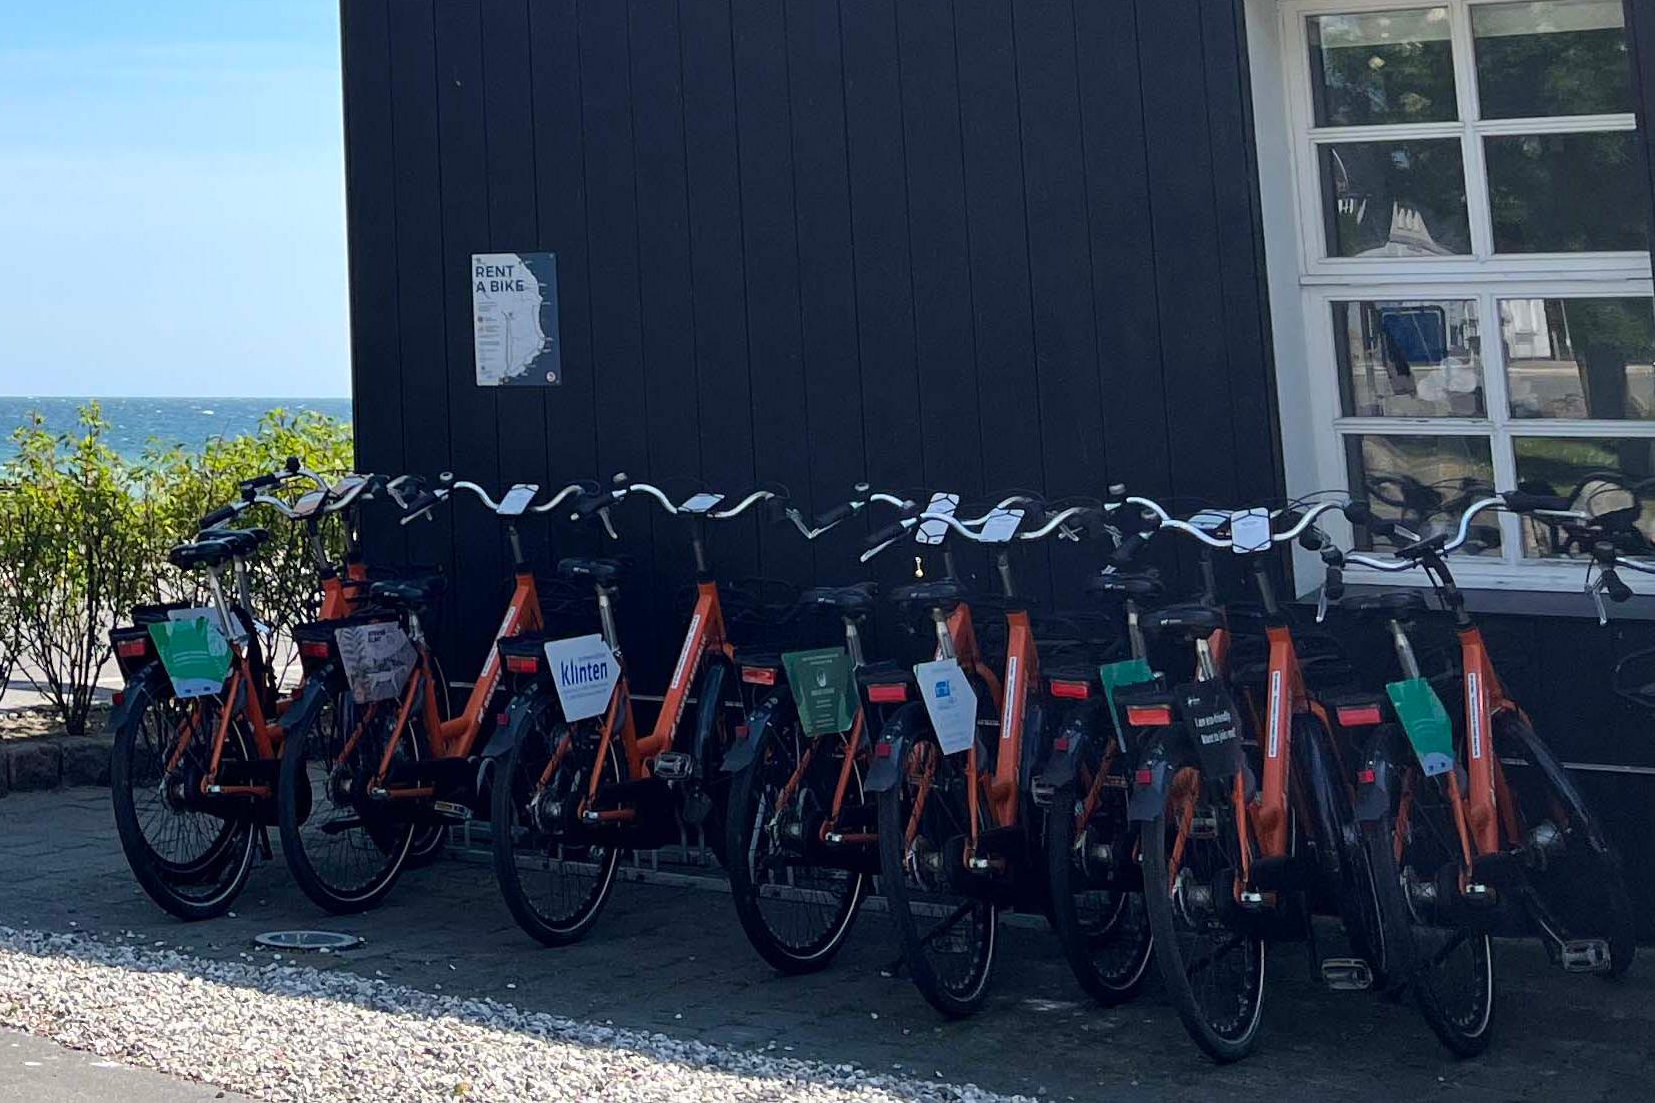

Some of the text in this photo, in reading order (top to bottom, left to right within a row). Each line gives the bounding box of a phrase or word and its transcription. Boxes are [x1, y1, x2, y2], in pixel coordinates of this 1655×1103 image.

[475, 265, 514, 278] RENT
[475, 279, 525, 293] A BIKE
